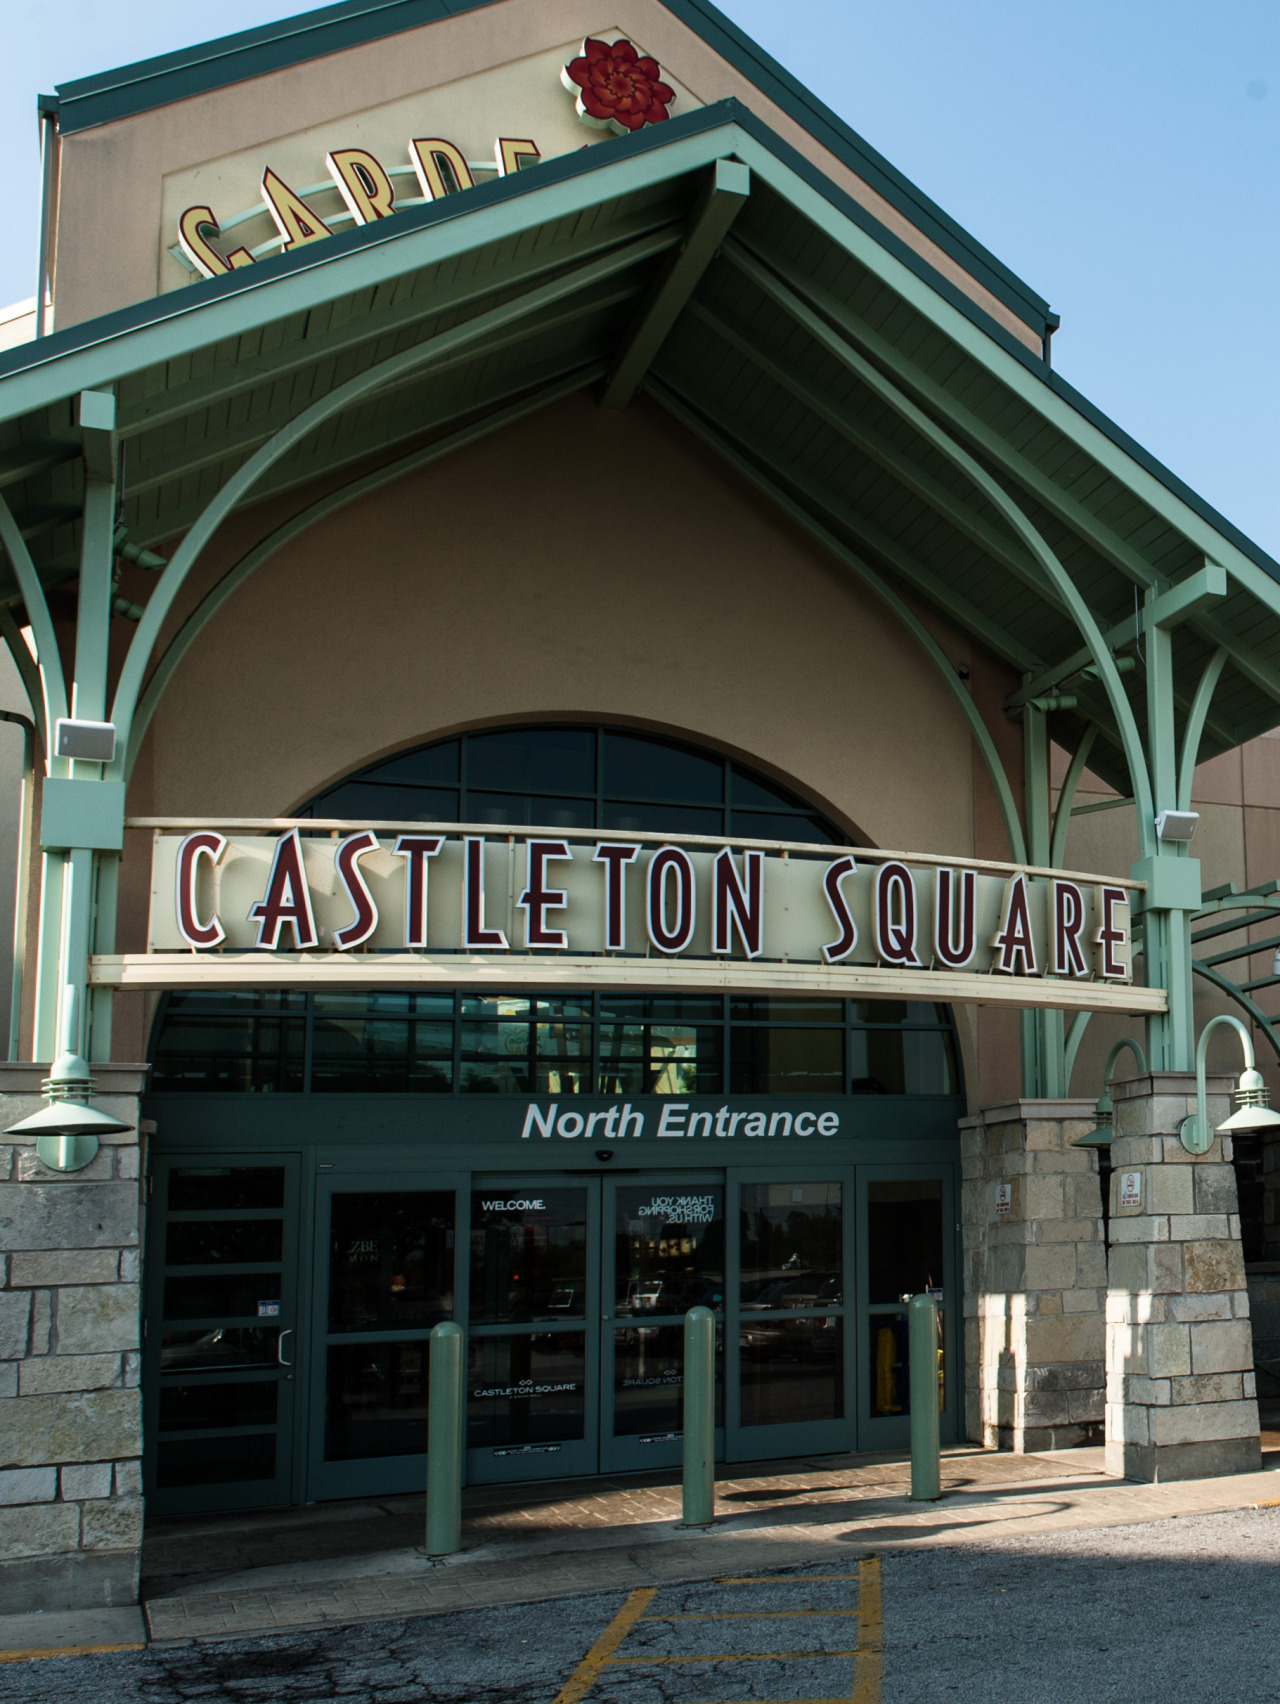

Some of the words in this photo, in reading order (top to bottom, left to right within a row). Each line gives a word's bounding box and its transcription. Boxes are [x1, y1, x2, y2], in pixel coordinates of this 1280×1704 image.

[174, 825, 765, 960] CASTLETON
[820, 855, 1129, 979] SQUARE
[521, 1103, 645, 1138] North
[656, 1103, 840, 1137] Entrance
[481, 1199, 546, 1211] WELCOME.
[474, 1386, 534, 1397] CASTLETON
[535, 1383, 577, 1393] SQUARE
